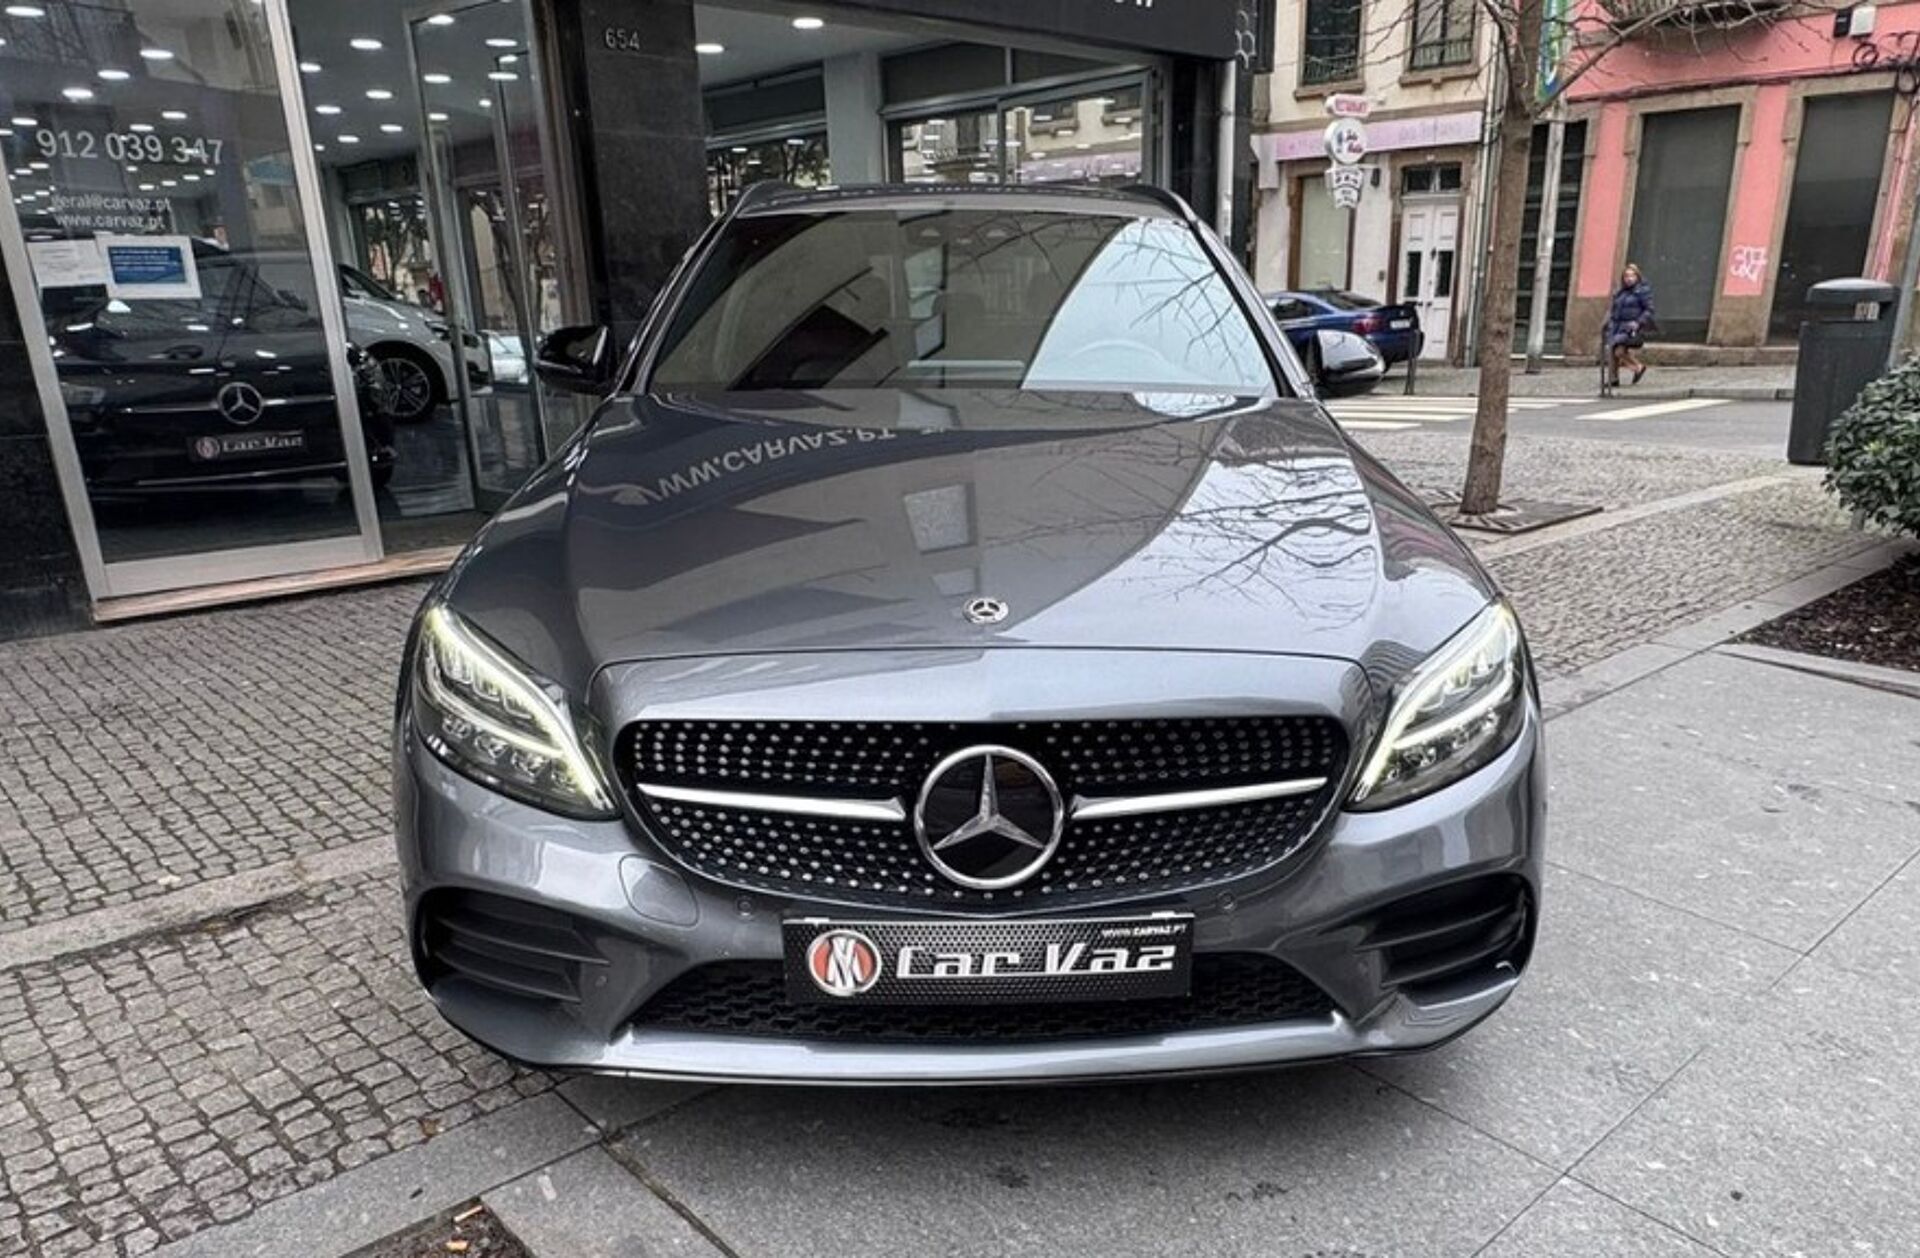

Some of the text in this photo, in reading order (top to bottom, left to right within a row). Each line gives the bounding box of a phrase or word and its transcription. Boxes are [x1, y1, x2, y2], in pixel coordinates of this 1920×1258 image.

[605, 27, 640, 50] 654
[36, 129, 223, 165] 912 039 347
[54, 214, 165, 231] www.carvaz.pt
[897, 942, 1176, 979] Car Vaz
